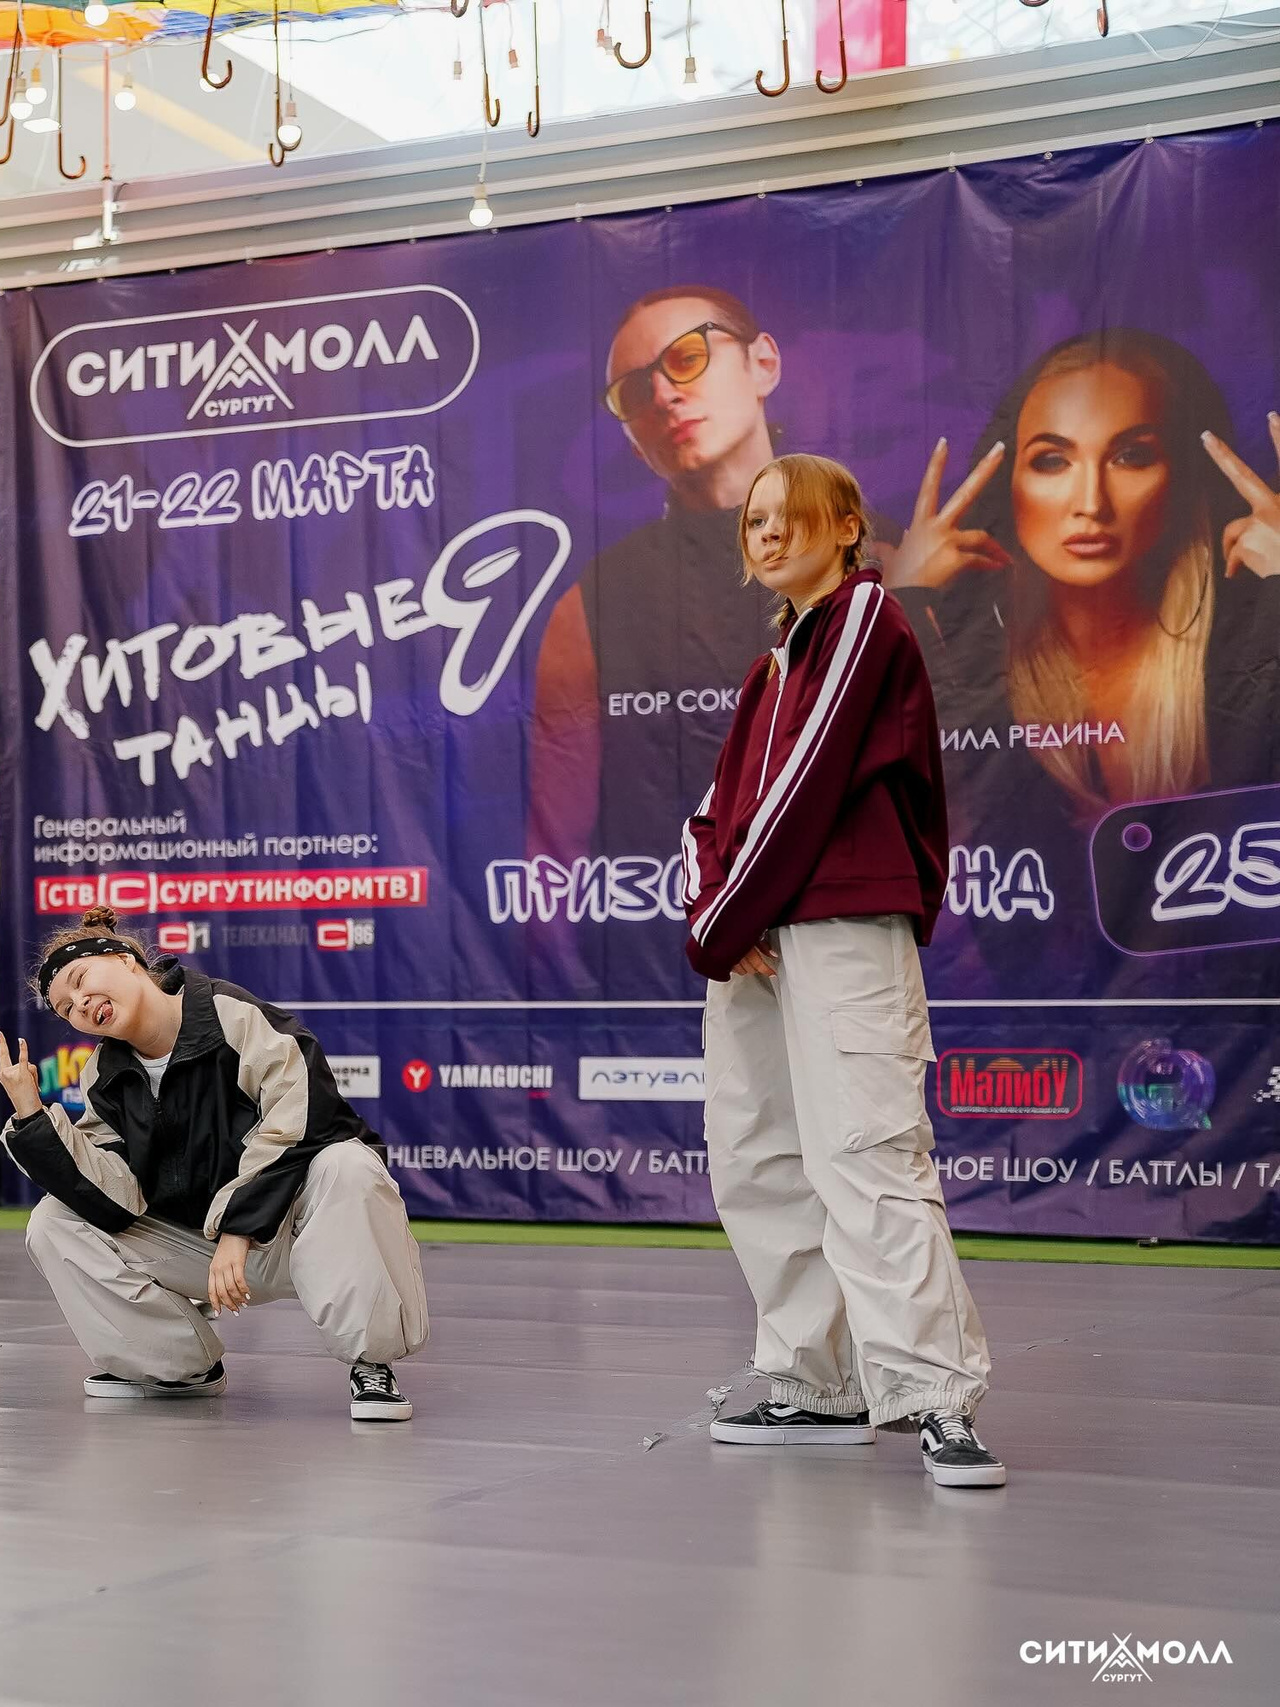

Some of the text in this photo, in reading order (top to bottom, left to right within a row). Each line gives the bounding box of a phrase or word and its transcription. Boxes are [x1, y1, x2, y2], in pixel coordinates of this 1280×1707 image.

[66, 315, 439, 397] СИТИ МОЛЛ
[203, 395, 276, 419] СУРГУТ
[68, 444, 435, 537] 21-22 МАРТА
[29, 579, 432, 740] ХИТОВЫЕ
[608, 688, 744, 716] ЕГОР СОК
[114, 661, 372, 786] ТАНЦЫ
[1009, 720, 1126, 750] РЕДИНА
[34, 808, 188, 840] Генеральный
[34, 832, 380, 867] информационный партнер:
[222, 923, 309, 948] ТЕЛЕКАНАЛ
[438, 1064, 554, 1088] YAMAGUCHI
[557, 1148, 623, 1173] ШОУ
[647, 1149, 710, 1175] БАТТ
[1002, 1156, 1078, 1183] ШОУ
[1108, 1160, 1222, 1187] БАТТЛЫ
